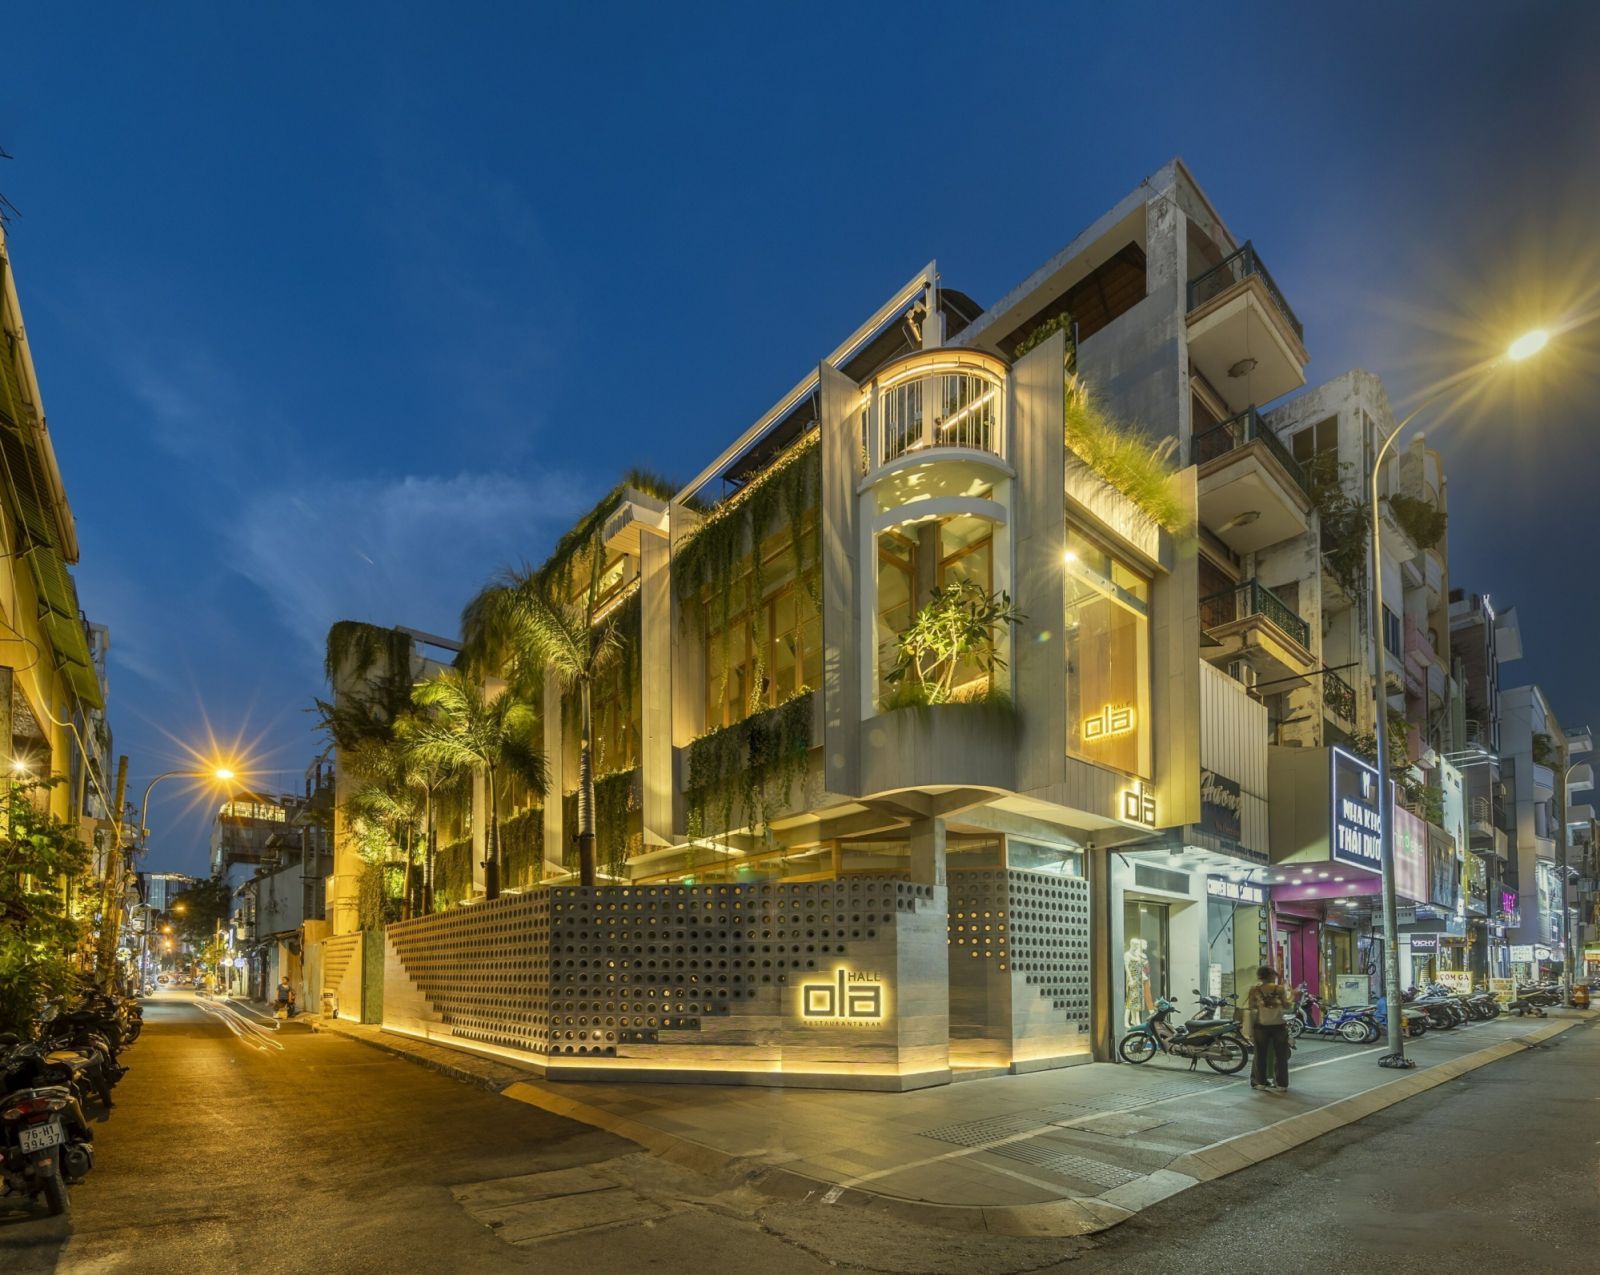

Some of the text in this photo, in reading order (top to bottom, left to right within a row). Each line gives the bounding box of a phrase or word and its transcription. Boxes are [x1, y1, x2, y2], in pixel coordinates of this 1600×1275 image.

[1411, 939, 1437, 948] VICHY
[25, 1125, 54, 1141] 76-H1
[23, 1133, 61, 1153] 394.37
